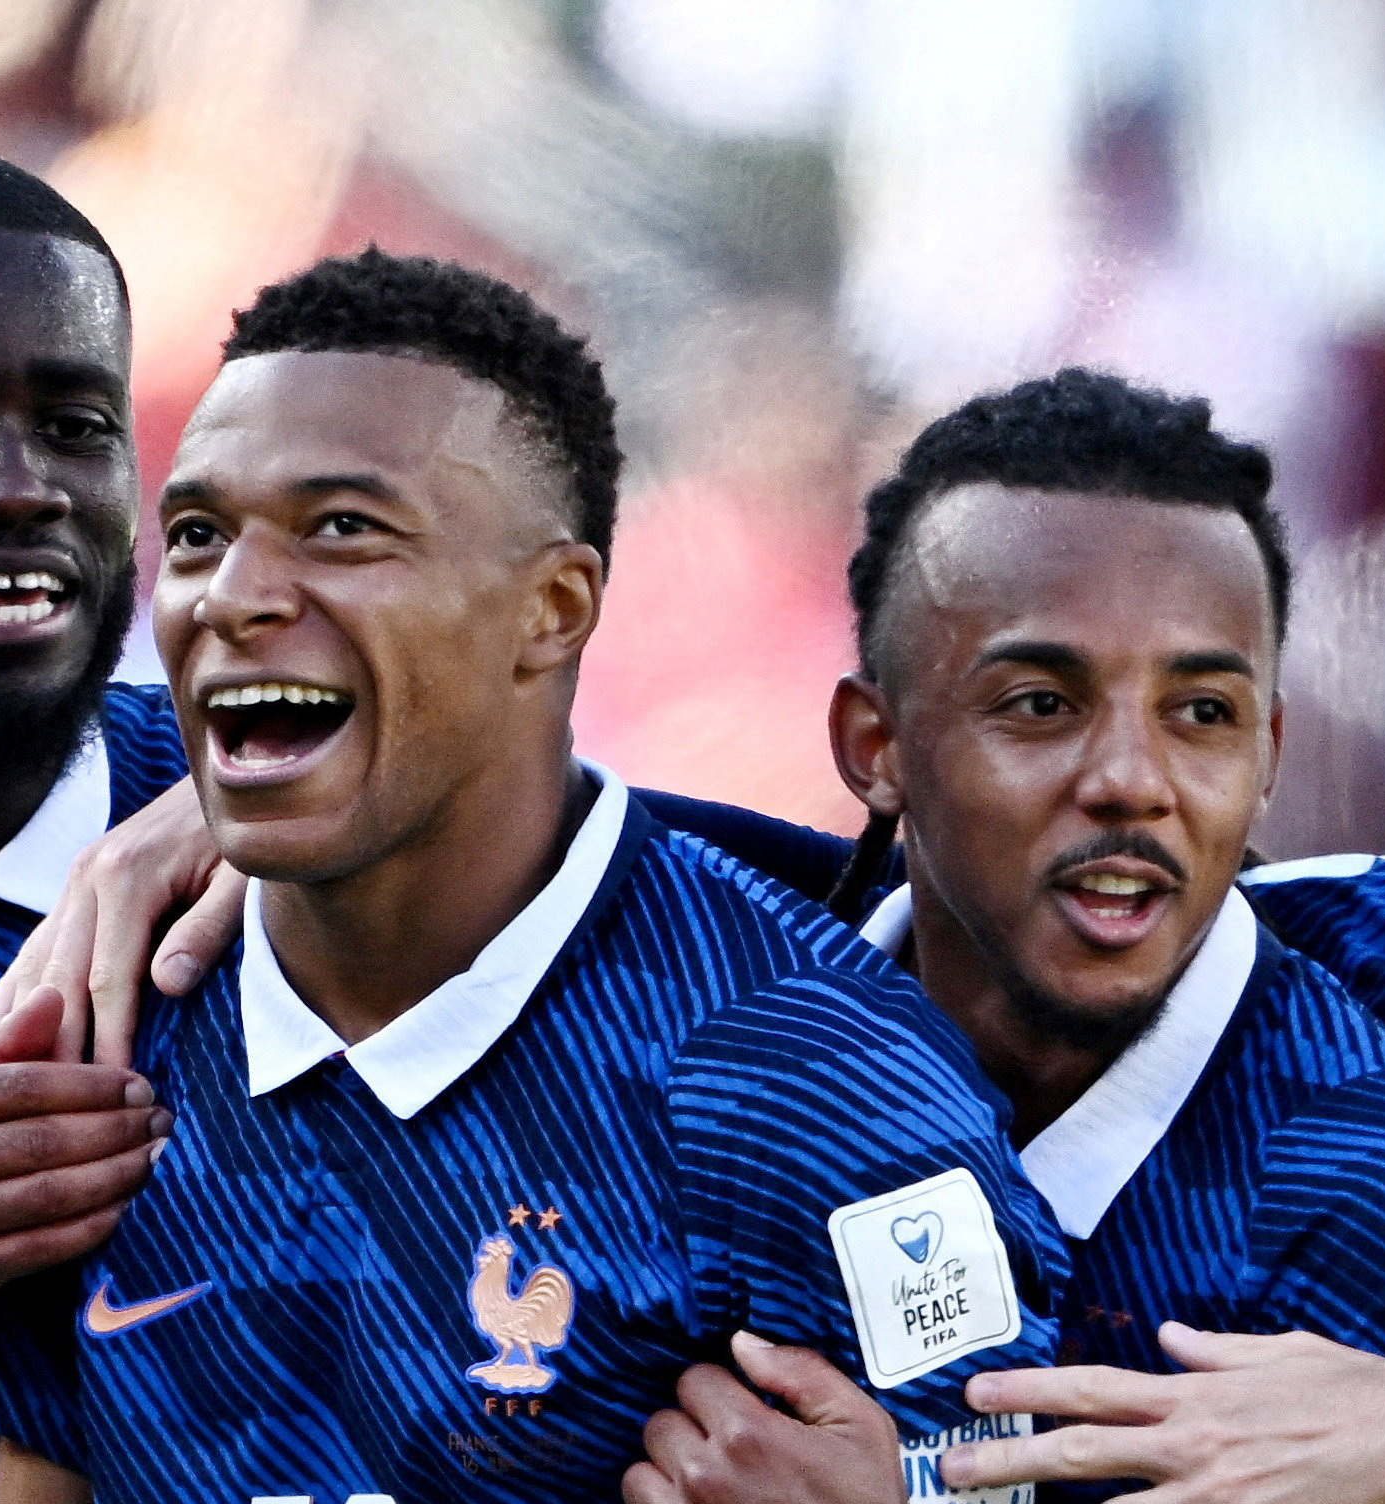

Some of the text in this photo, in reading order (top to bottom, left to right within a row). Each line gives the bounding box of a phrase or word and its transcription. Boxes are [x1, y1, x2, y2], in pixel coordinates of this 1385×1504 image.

[891, 1257, 967, 1307] Unite For
[903, 1287, 970, 1336] PEACE
[923, 1327, 958, 1350] FIFA
